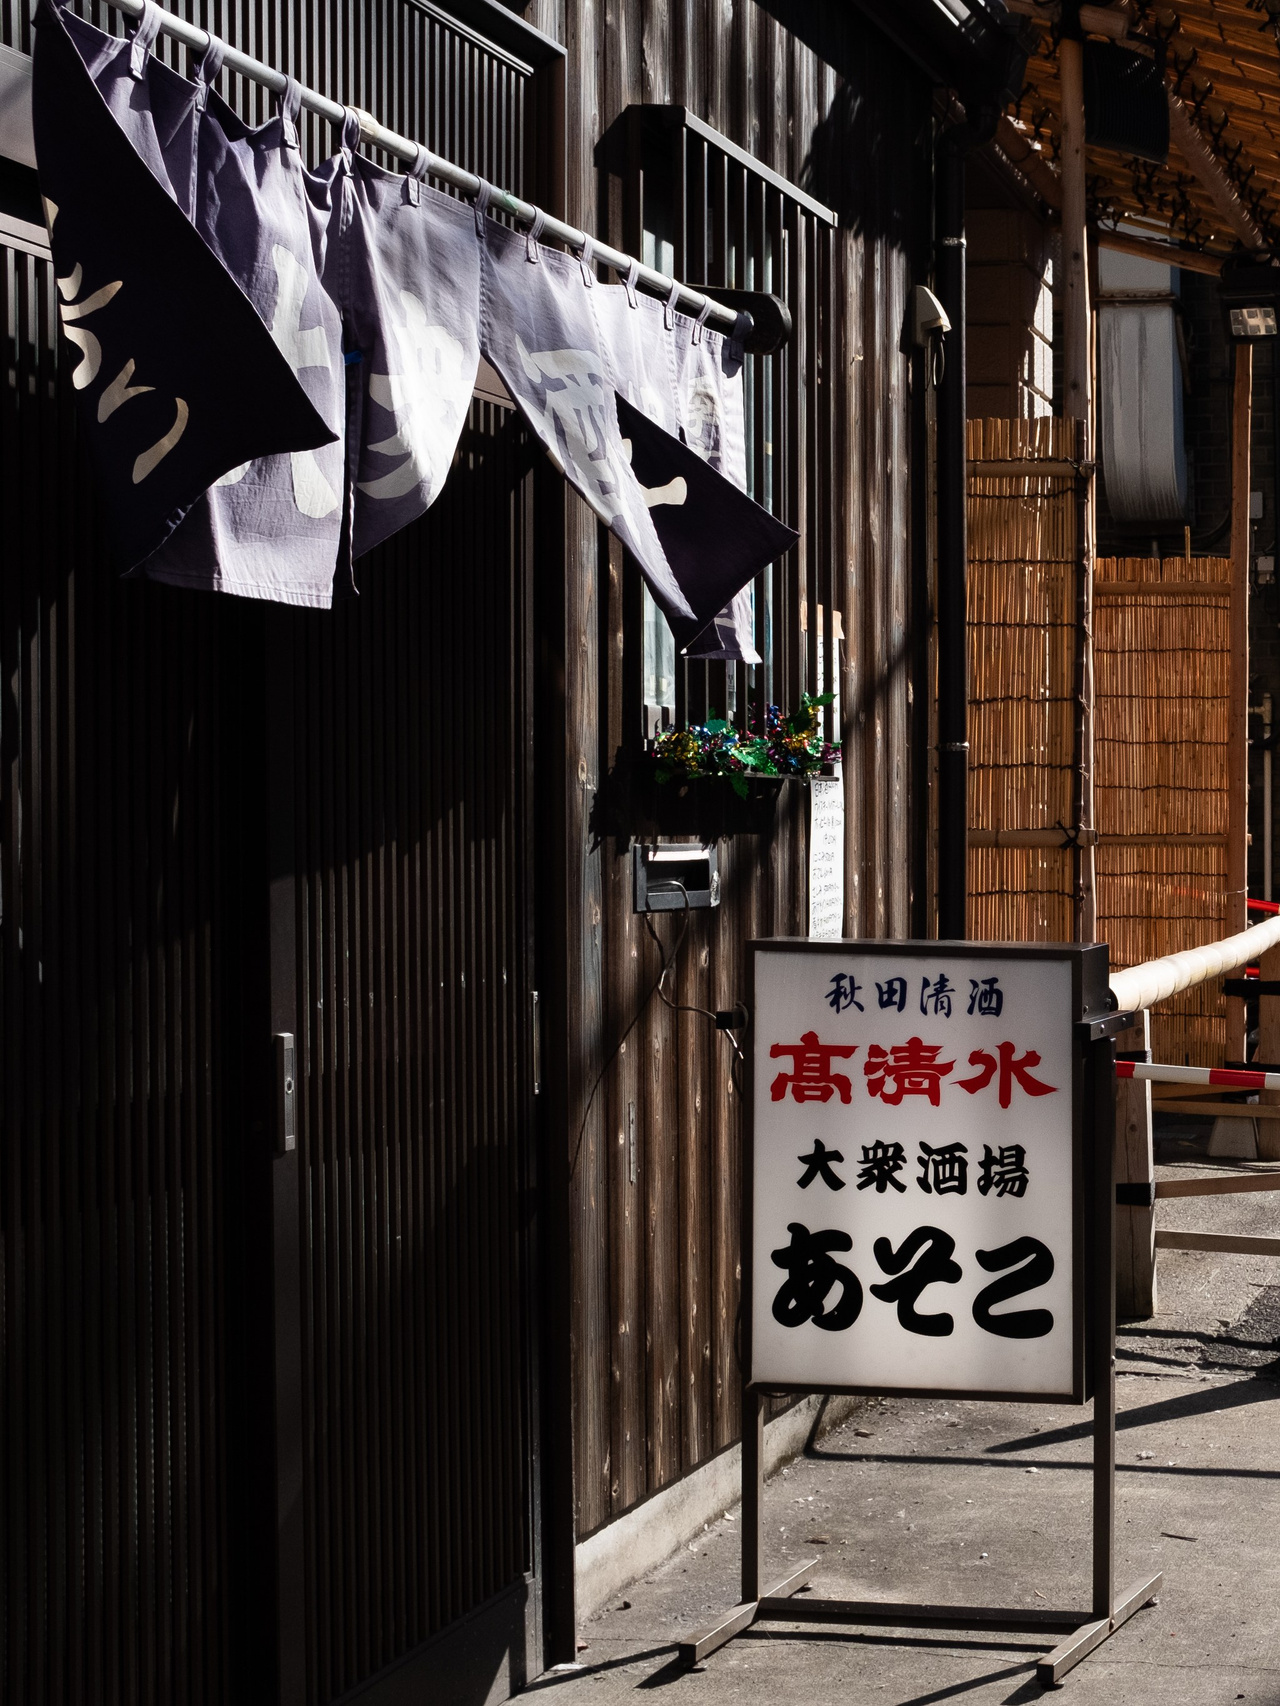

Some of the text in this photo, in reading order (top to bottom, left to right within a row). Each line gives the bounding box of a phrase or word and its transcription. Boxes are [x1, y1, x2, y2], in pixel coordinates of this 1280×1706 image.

[824, 972, 1004, 1019] 秋田清酒
[796, 1138, 1030, 1198] 大衆酒場
[770, 1222, 1055, 1340] あそこ
